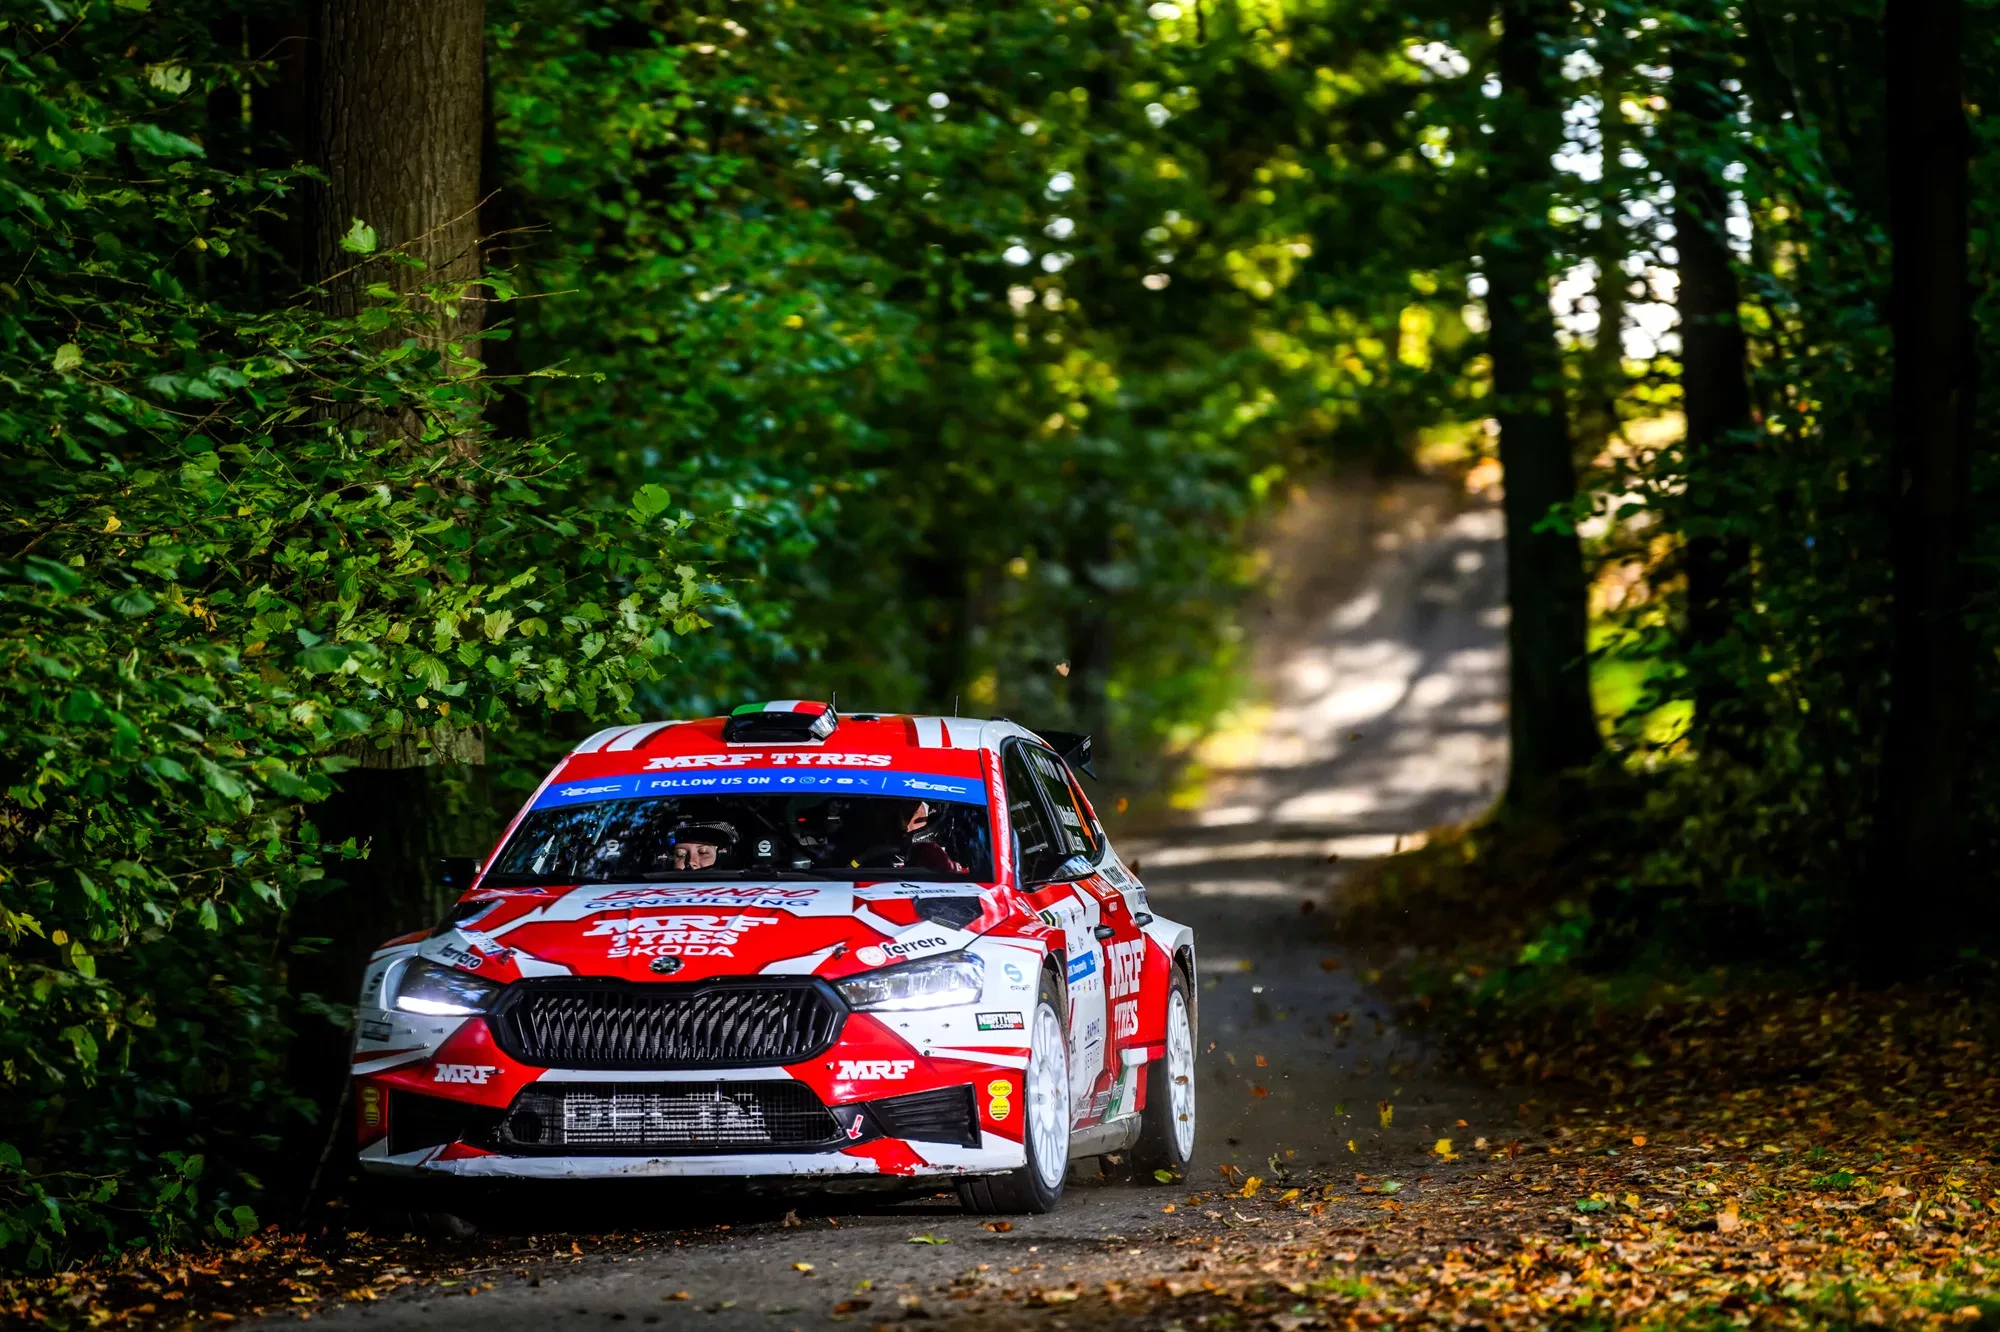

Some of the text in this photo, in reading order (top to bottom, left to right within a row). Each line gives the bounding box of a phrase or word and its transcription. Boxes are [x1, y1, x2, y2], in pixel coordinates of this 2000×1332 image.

[643, 753, 892, 770] MRF TYRES
[651, 776, 771, 788] FOLLOW US ON
[911, 780, 967, 794] ERC
[584, 897, 810, 909] CONSULTING
[582, 915, 779, 936] MRF
[611, 930, 739, 947] TYRES
[882, 937, 948, 957] ferrero
[1107, 939, 1144, 999] MRF
[434, 1063, 496, 1084] MRF
[836, 1060, 915, 1080] MRF
